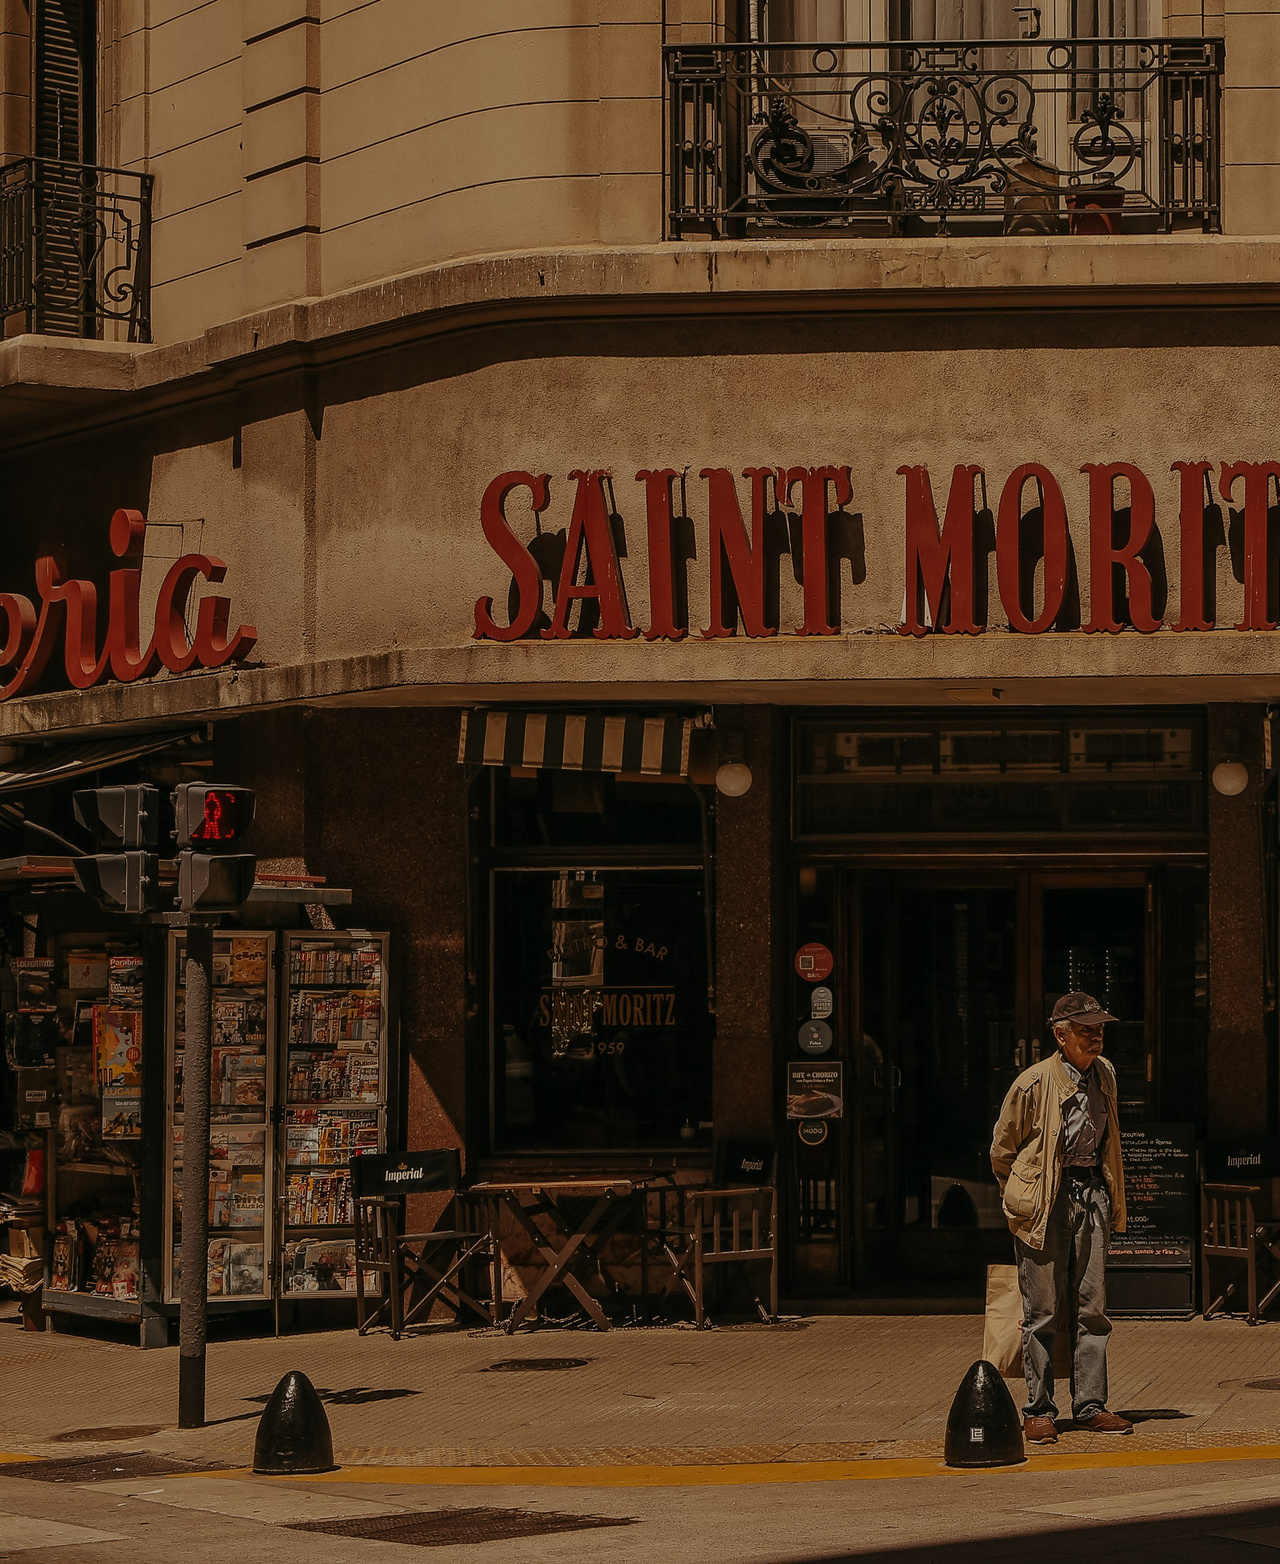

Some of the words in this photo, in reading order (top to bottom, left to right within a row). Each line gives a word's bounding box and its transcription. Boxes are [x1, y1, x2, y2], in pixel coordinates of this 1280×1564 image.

[474, 465, 853, 641] SAINT
[615, 934, 628, 950] &
[635, 937, 668, 961] BAR
[539, 992, 595, 1027] SAINT
[602, 992, 677, 1027] MORITZ
[590, 1042, 625, 1055] 1959
[1227, 1153, 1261, 1168] Imperial
[384, 1166, 425, 1183] Imperial
